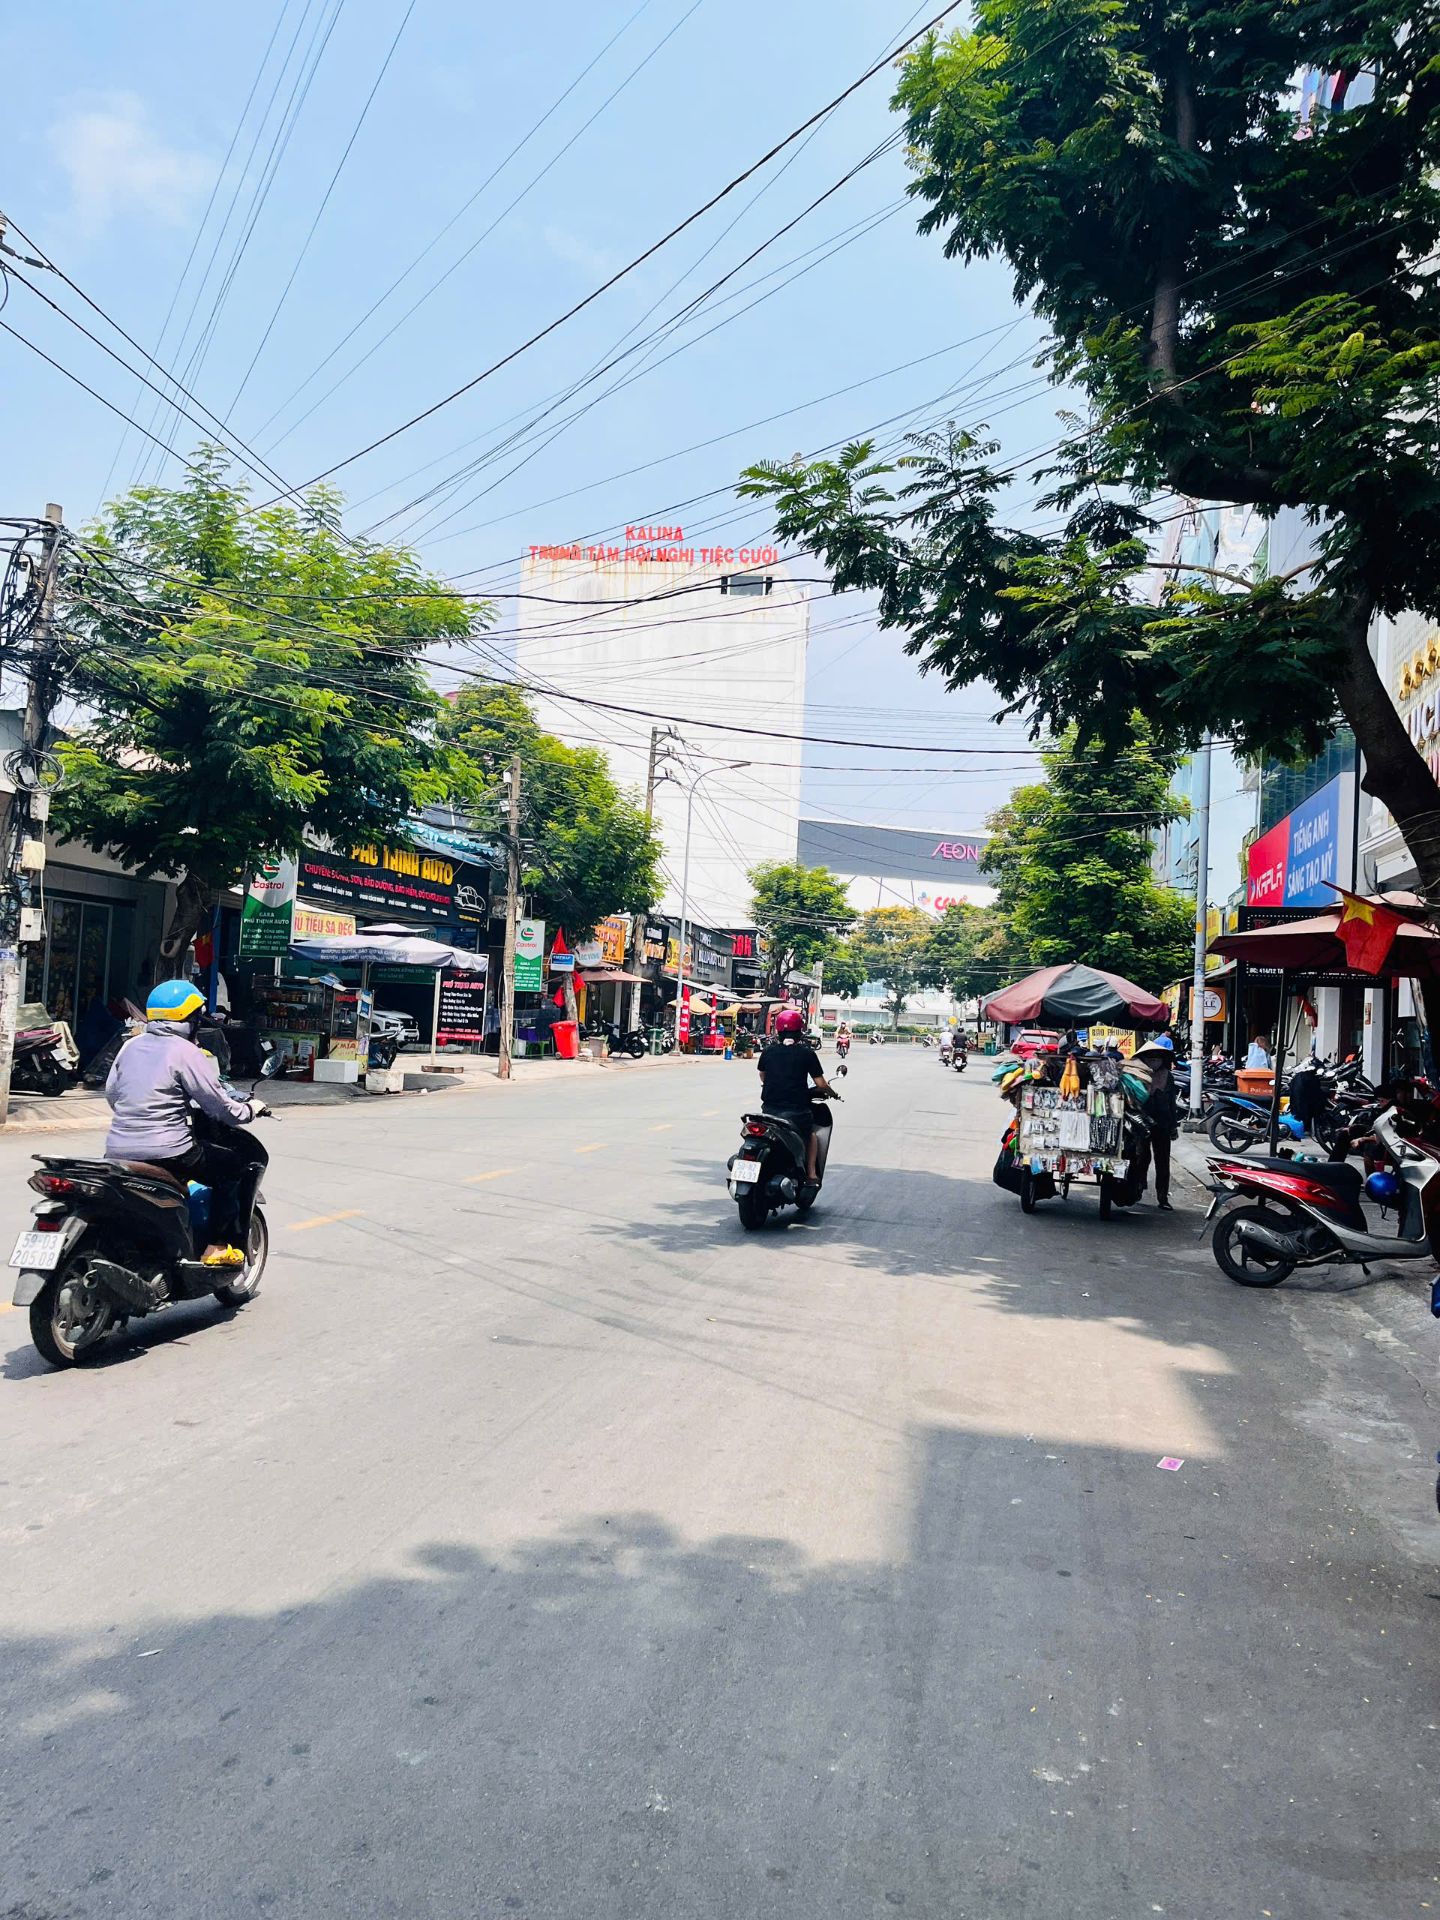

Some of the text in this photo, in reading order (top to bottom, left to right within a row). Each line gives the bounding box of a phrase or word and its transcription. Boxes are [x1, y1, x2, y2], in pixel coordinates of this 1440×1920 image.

[625, 525, 684, 541] KALINA
[529, 544, 778, 566] TRUNG TÂM HỘI NGHỊ TIỆC CƯỚI
[1293, 808, 1330, 857] TIẾNG ANH
[421, 857, 453, 885] AUTO
[1288, 842, 1334, 898] SÁNG TẠO MỸ
[253, 881, 285, 890] Castrol
[22, 1233, 59, 1249] 59-D3
[12, 1251, 55, 1267] 205.08
